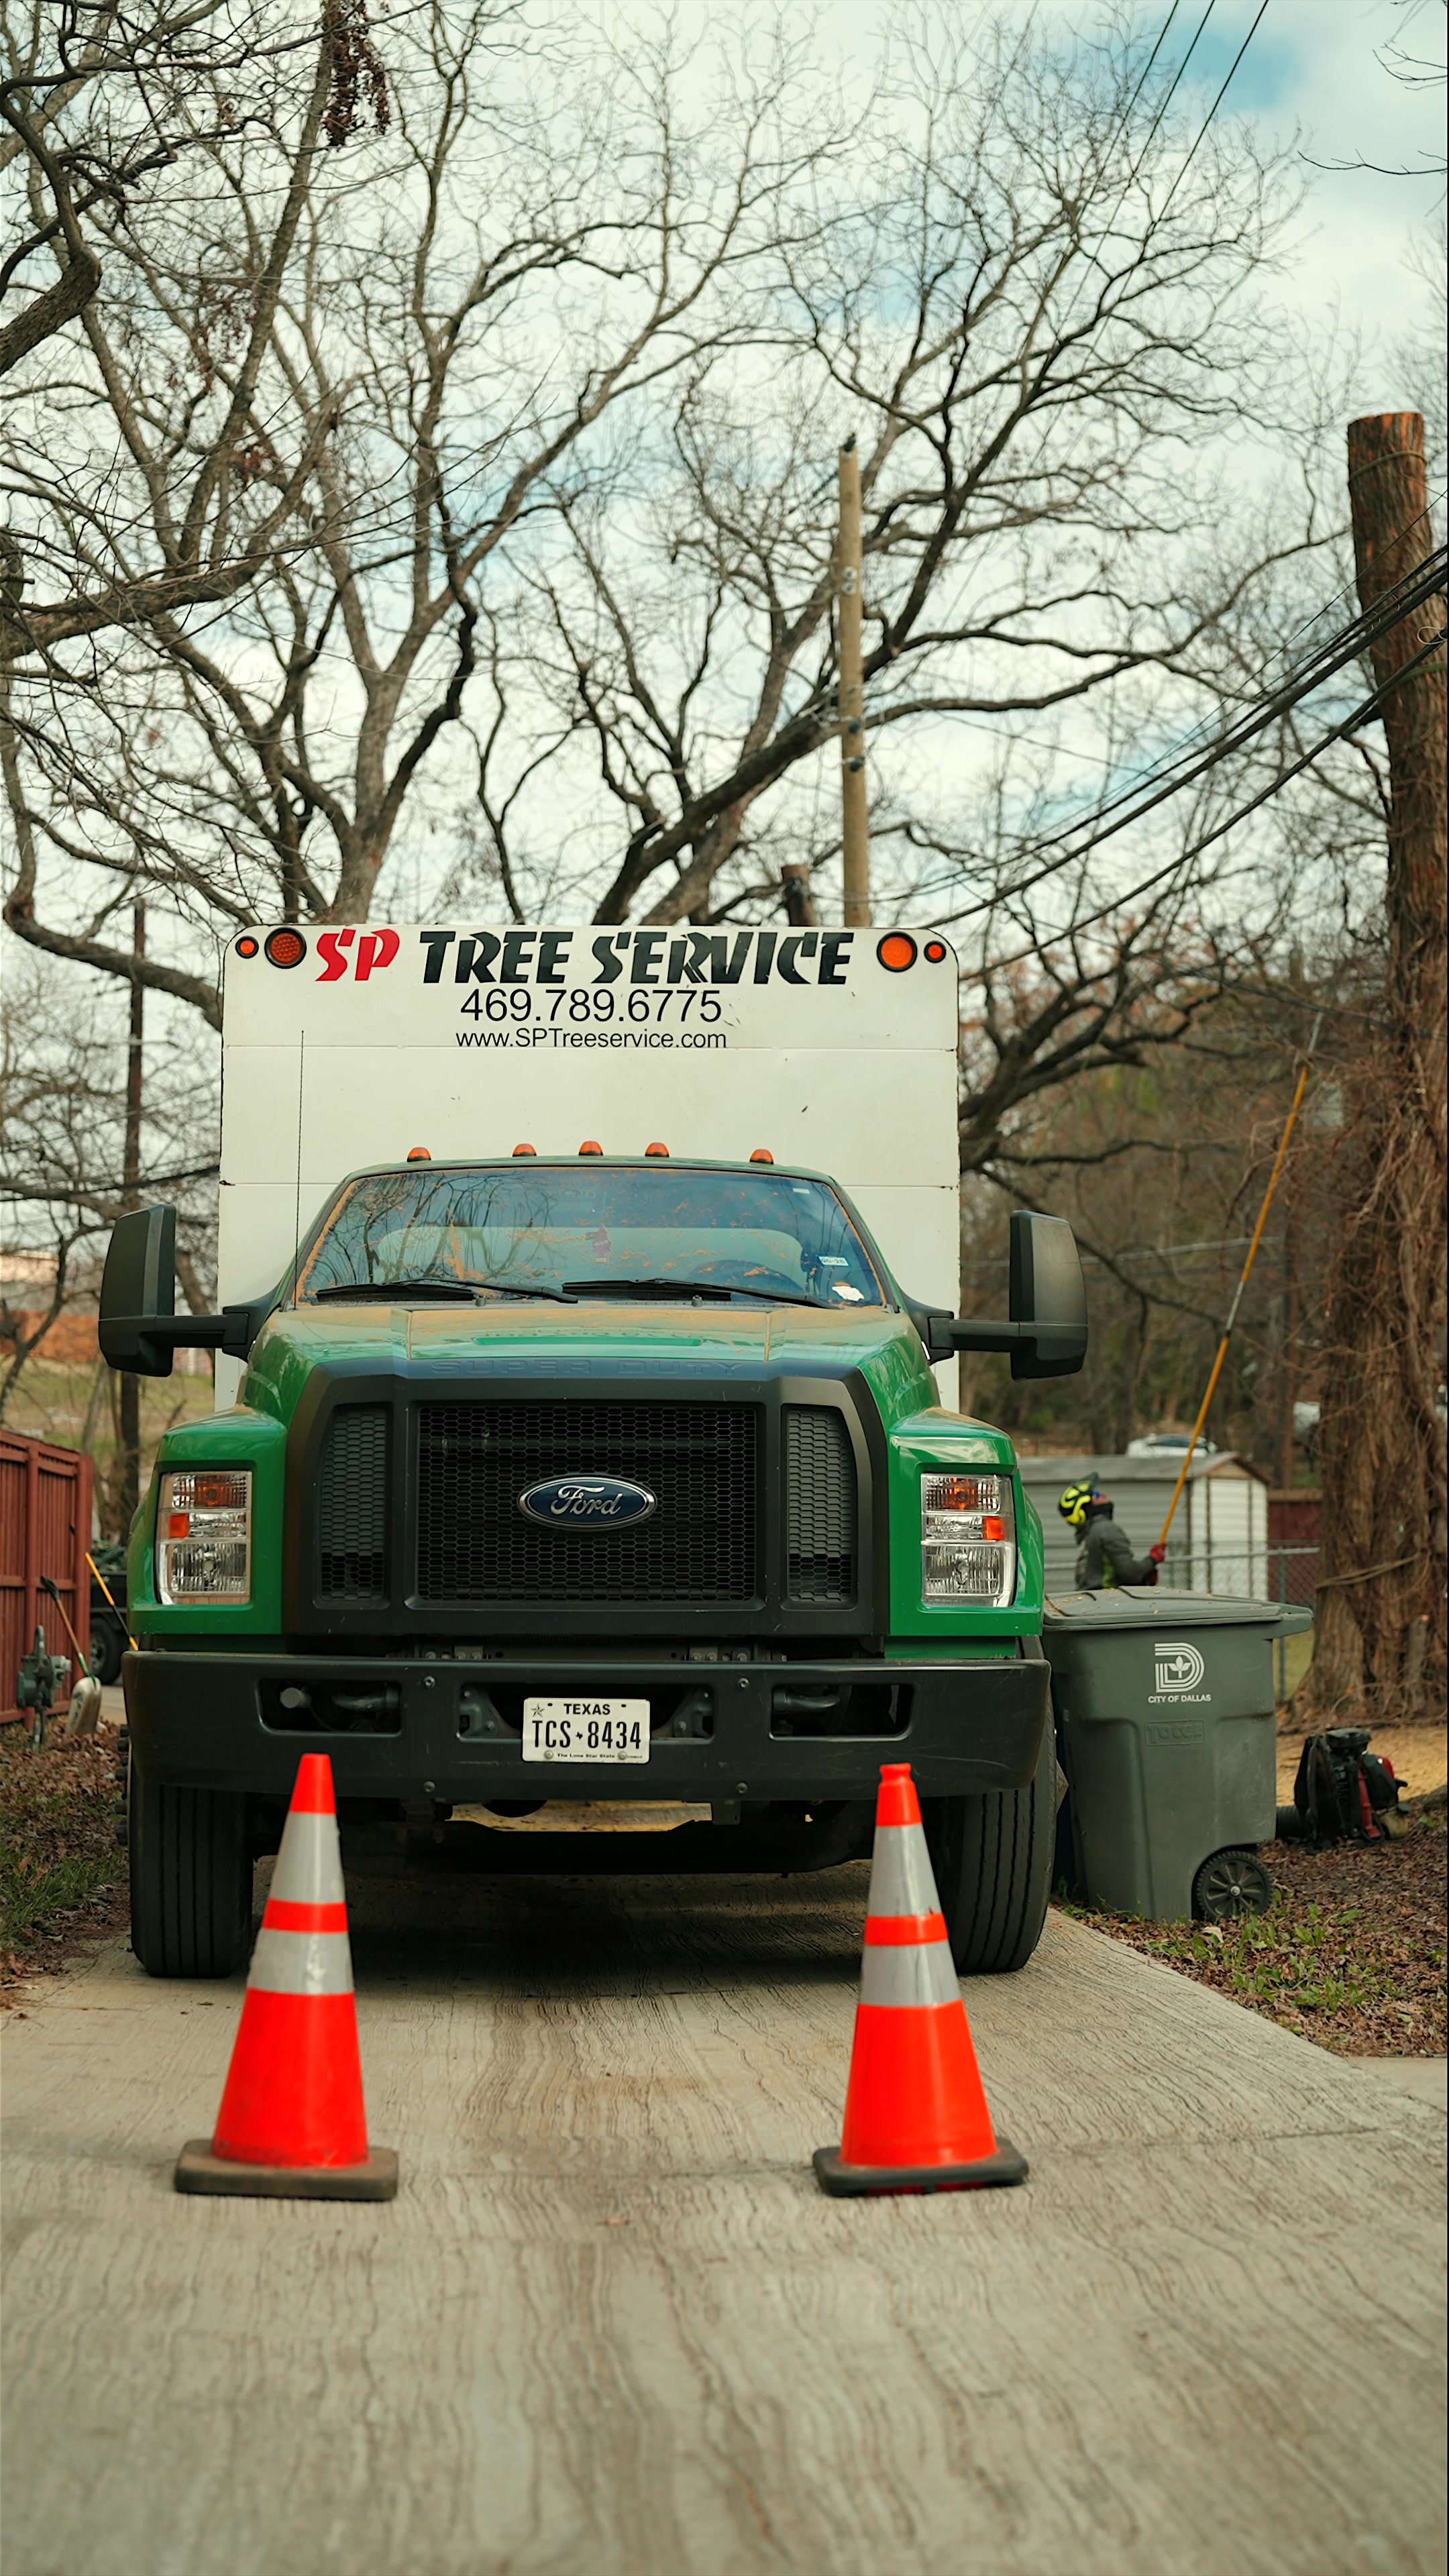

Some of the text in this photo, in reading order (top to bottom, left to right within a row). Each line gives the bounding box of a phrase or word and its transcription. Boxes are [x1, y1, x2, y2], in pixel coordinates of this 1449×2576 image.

[315, 928, 855, 985] SP TREE SERVICE
[460, 988, 722, 1022] 469.789.6775
[455, 1028, 727, 1048] www.SPTreeservice.com
[550, 1485, 623, 1515] Ford
[564, 1703, 610, 1715] TEXAS
[1181, 1694, 1212, 1703] DALLAS
[532, 1720, 641, 1749] TCS 8434
